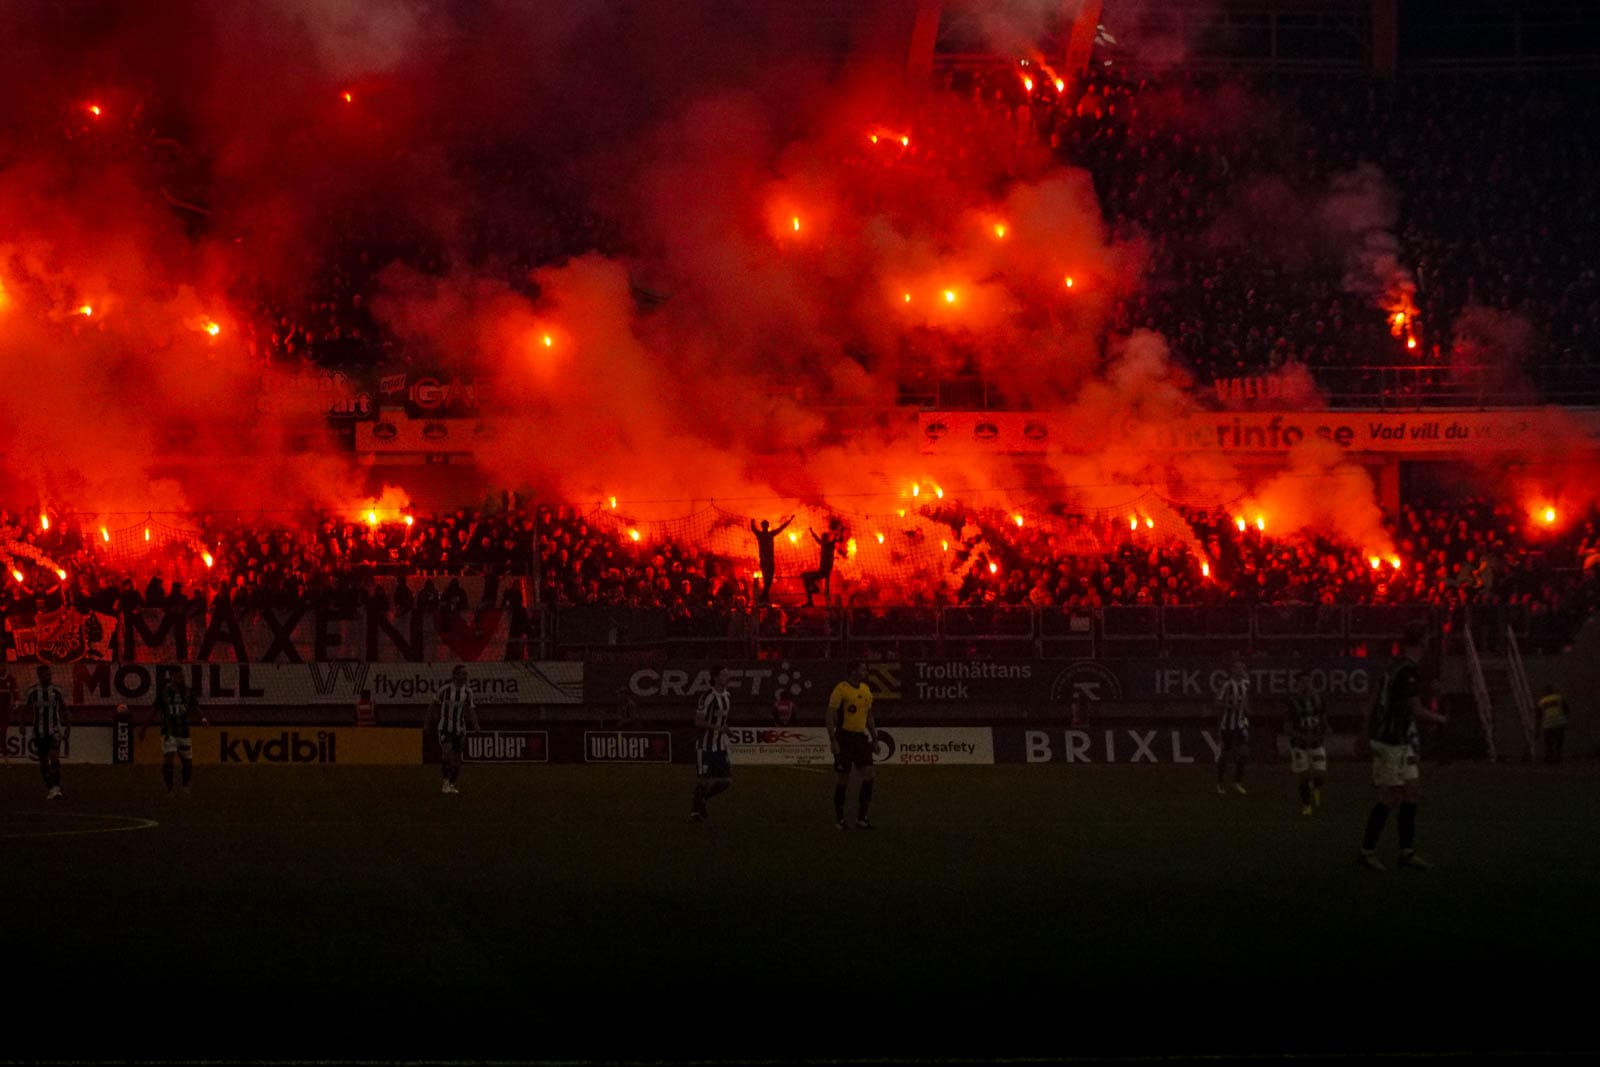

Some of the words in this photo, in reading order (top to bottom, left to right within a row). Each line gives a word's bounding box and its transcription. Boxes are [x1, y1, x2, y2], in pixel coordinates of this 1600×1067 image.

[1369, 422, 1405, 440] Vad
[1411, 422, 1439, 440] vill
[1445, 422, 1468, 440] du
[120, 601, 422, 662] MAXEN
[915, 660, 1032, 680] Trollhättans
[1154, 668, 1200, 694] IFK
[915, 682, 968, 700] Truck
[118, 721, 129, 761] SELECT
[220, 731, 336, 763] kvdbil
[467, 731, 526, 759] weber
[591, 731, 649, 759] weber
[900, 751, 939, 765] group
